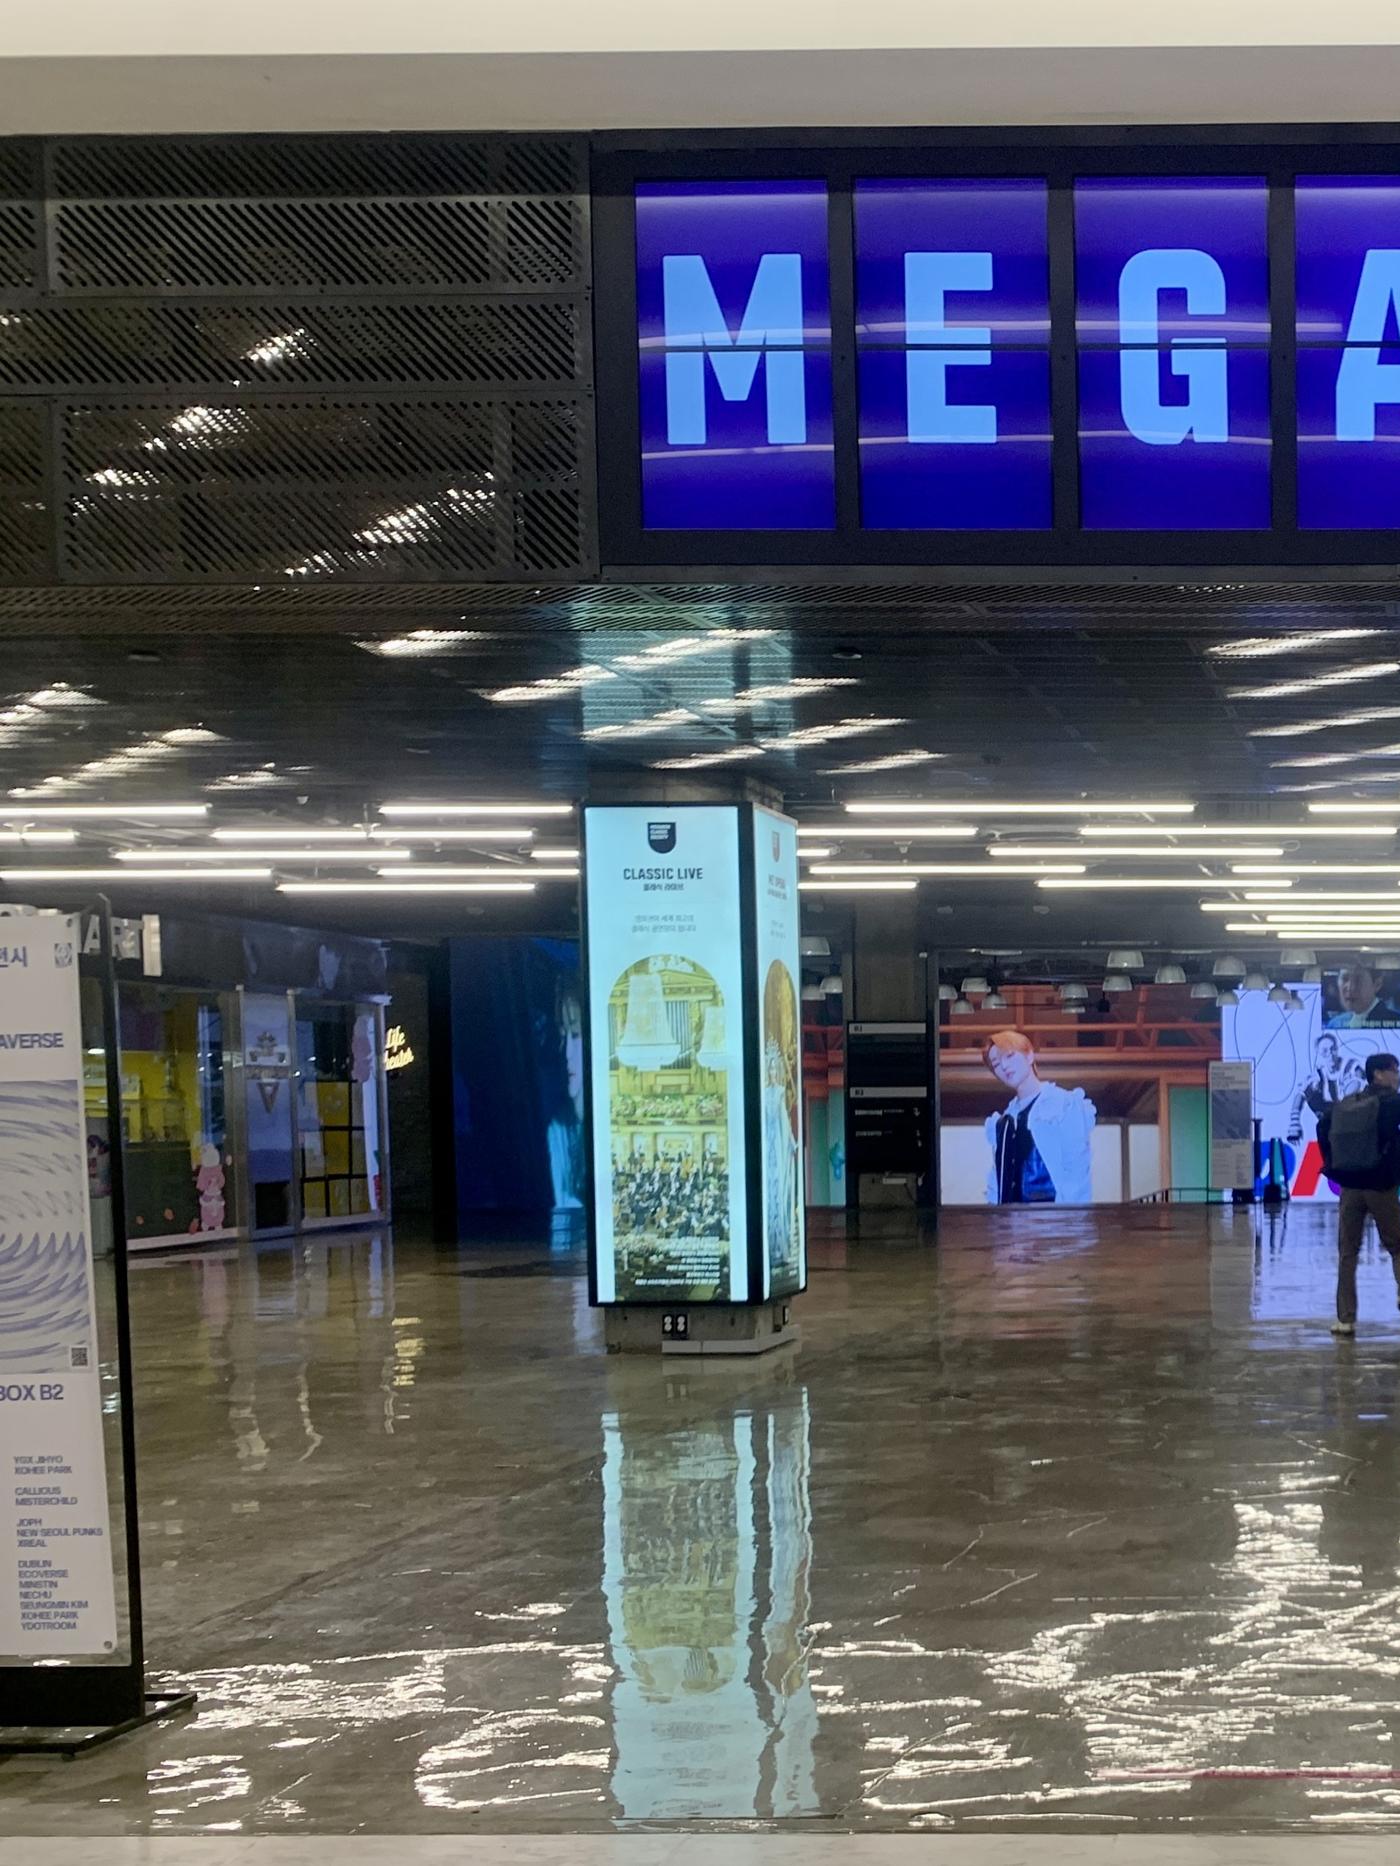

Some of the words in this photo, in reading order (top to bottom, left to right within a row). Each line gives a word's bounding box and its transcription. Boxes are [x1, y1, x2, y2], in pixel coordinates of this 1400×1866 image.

[623, 867, 674, 880] CLASSIC
[677, 867, 704, 880] LIVE
[40, 1384, 64, 1400] B2
[40, 1528, 71, 1537] SEOUL
